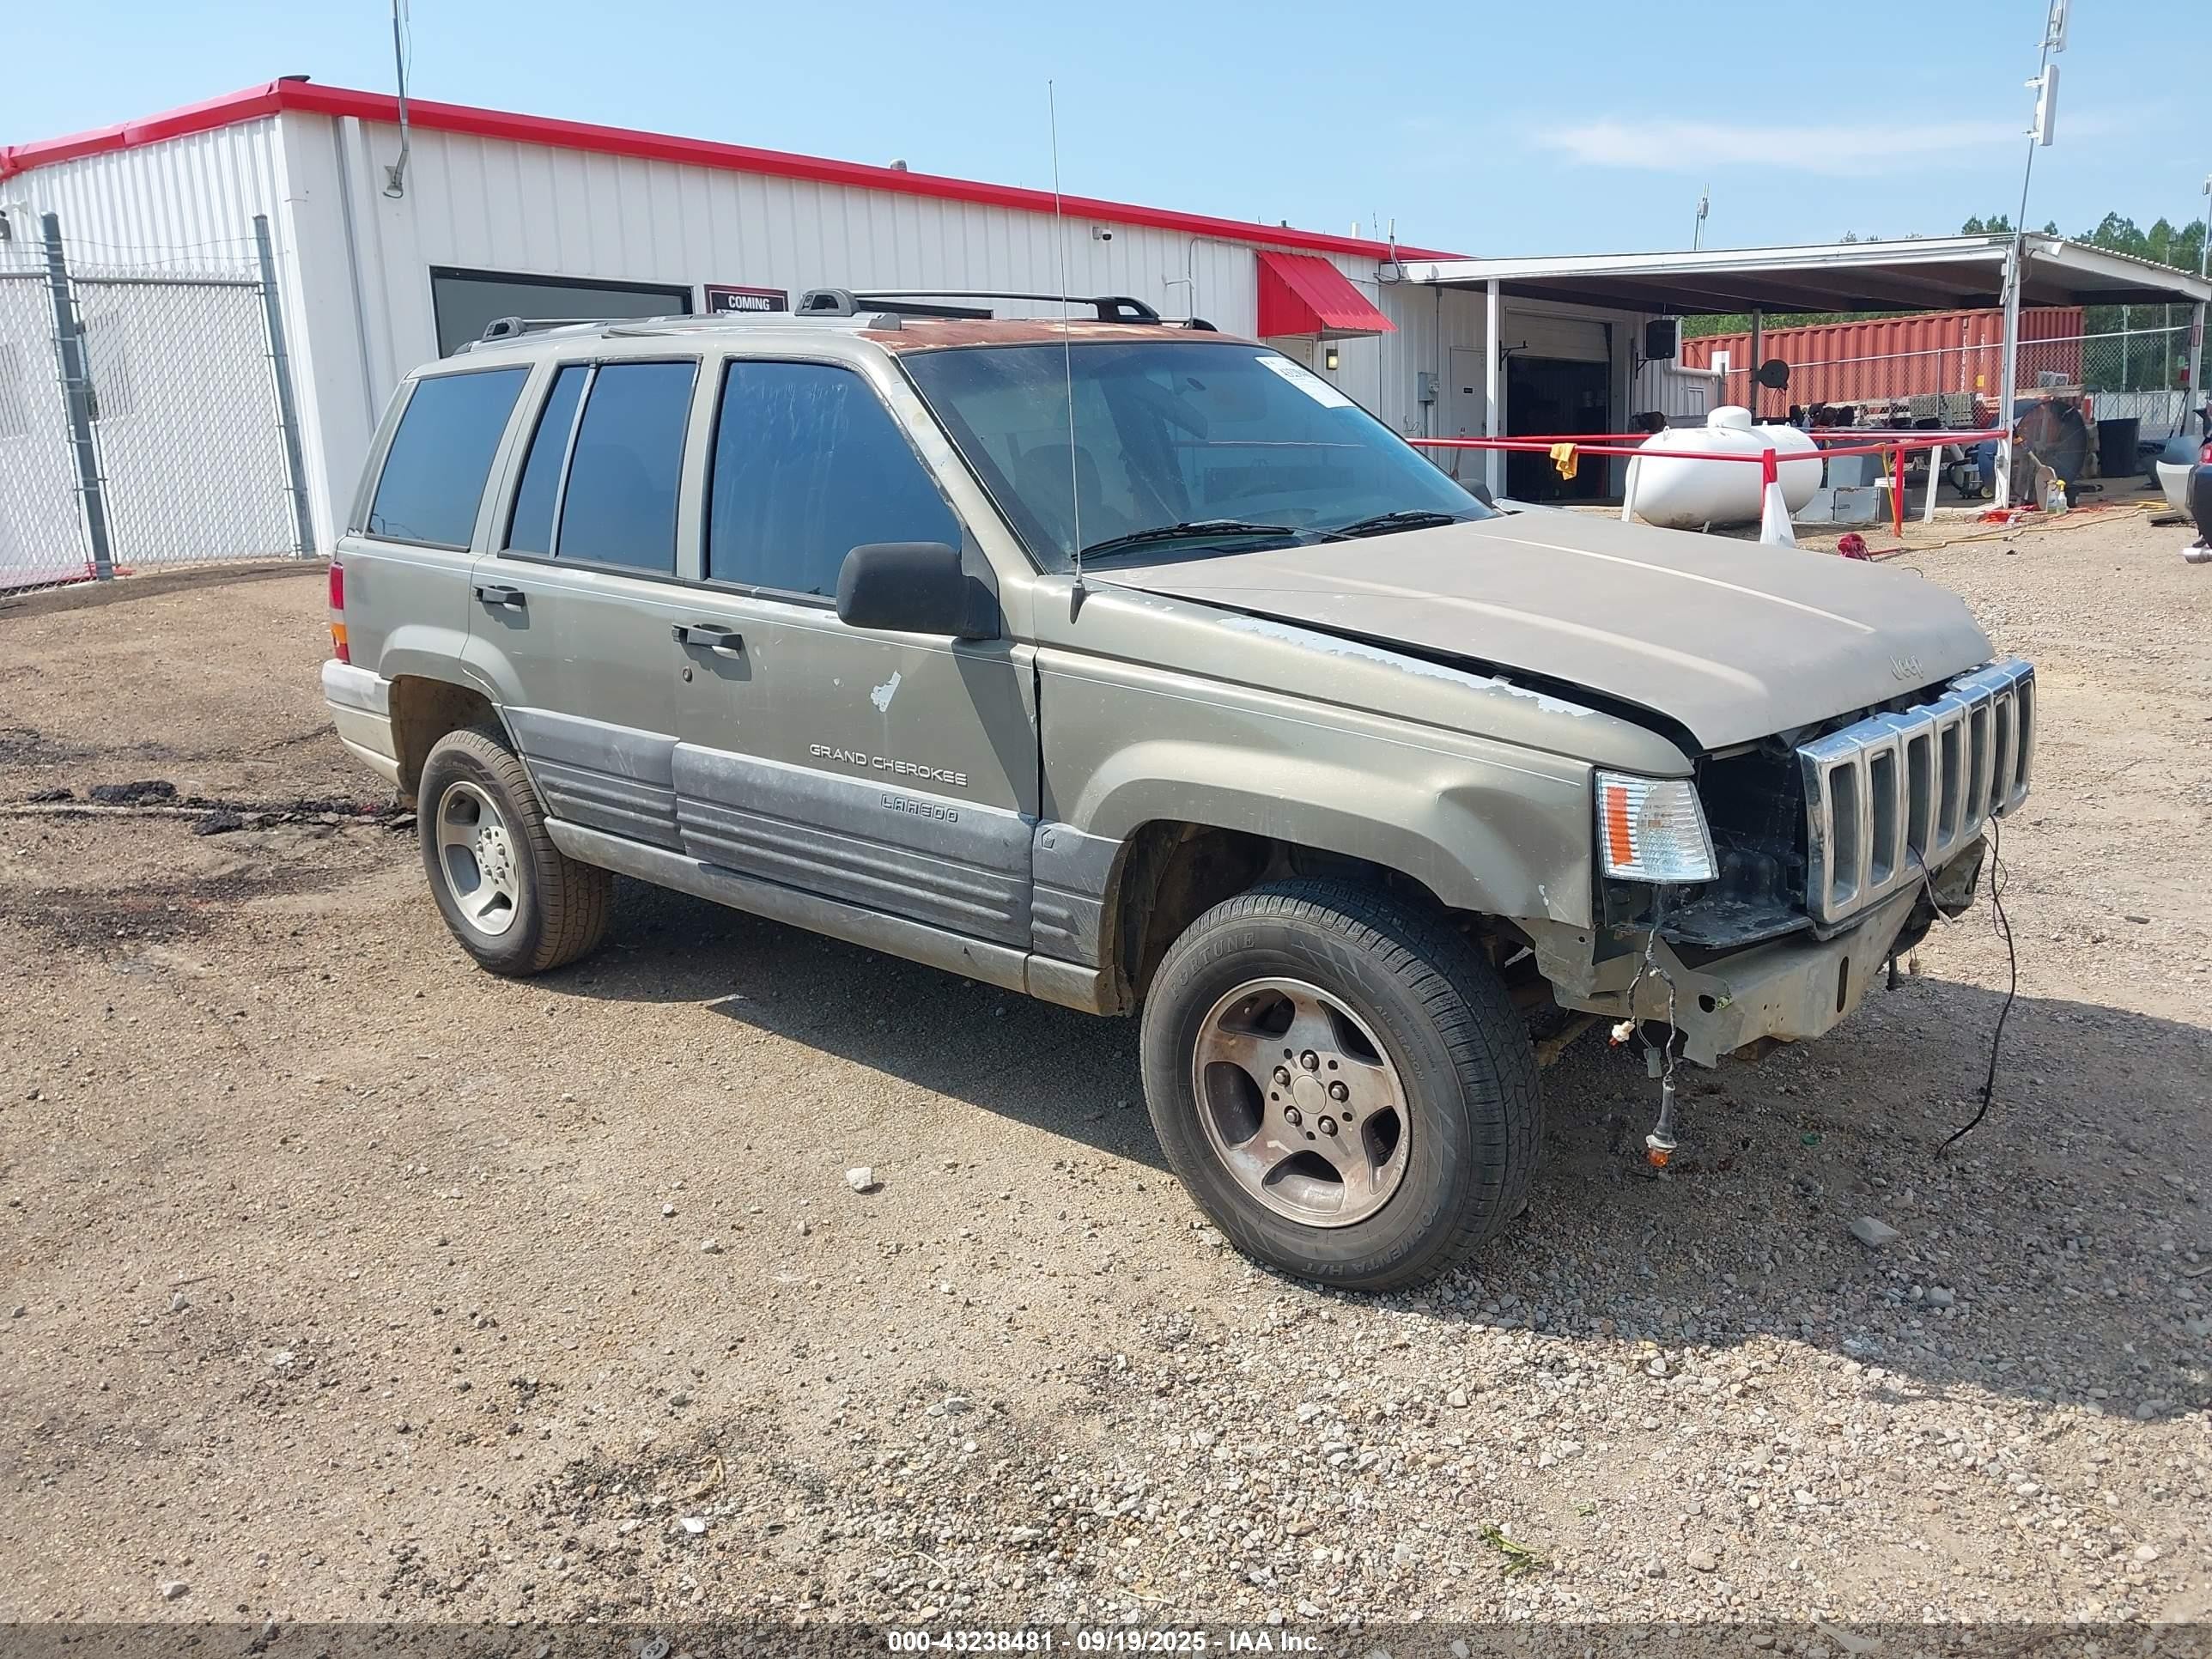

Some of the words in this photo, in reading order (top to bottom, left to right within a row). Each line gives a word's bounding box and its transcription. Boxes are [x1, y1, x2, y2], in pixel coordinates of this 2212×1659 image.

[728, 295, 770, 310] COMING
[1889, 654, 1923, 680] Jeep
[810, 744, 868, 766] GRAND
[872, 756, 969, 787] CHEROKEE
[881, 793, 959, 823] LAREDO
[1170, 932, 1256, 1003] FORTUNE
[1374, 1006, 1393, 1026] ALL
[1393, 1028, 1425, 1082] SEASON
